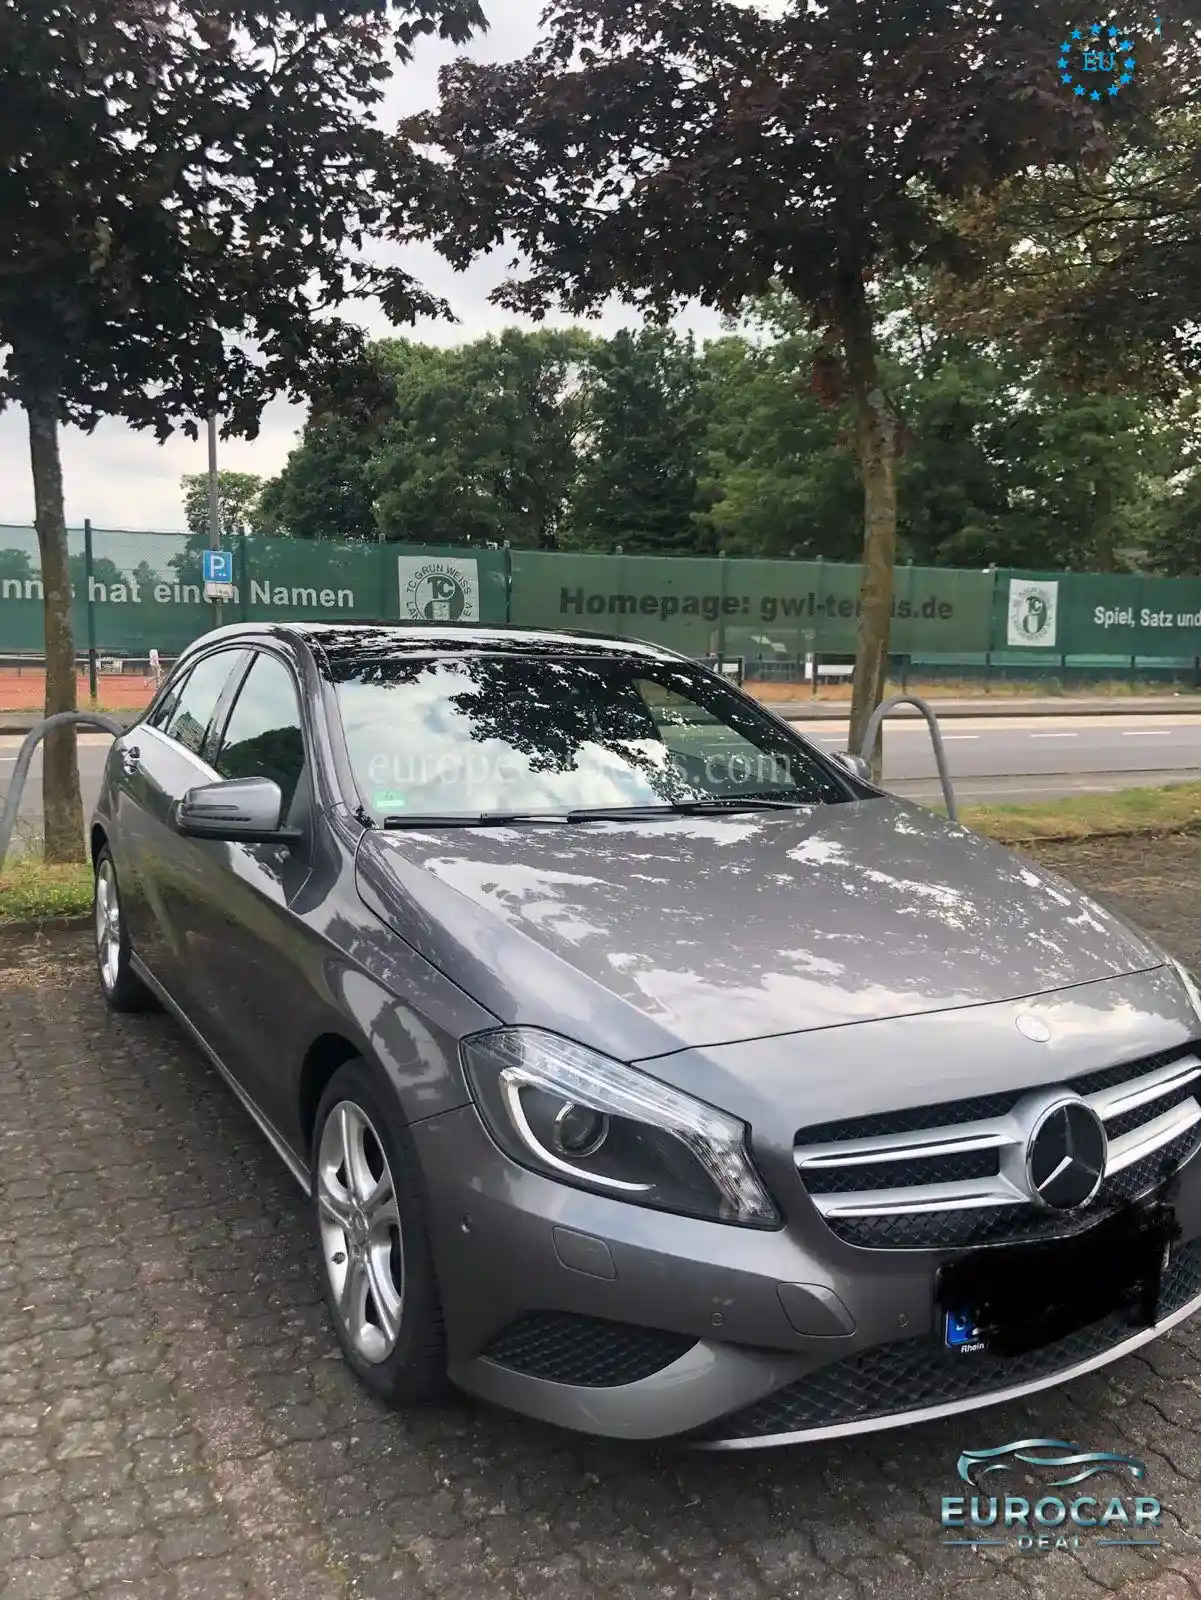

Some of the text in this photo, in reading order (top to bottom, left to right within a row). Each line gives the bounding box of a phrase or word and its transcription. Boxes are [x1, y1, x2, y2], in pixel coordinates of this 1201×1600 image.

[211, 554, 225, 577] P
[447, 565, 472, 594] WEISS
[89, 576, 141, 603] hat
[251, 580, 354, 608] Namen
[560, 587, 750, 621] Homepage:
[1094, 606, 1135, 628] Spiel,
[1140, 608, 1174, 627] Satz
